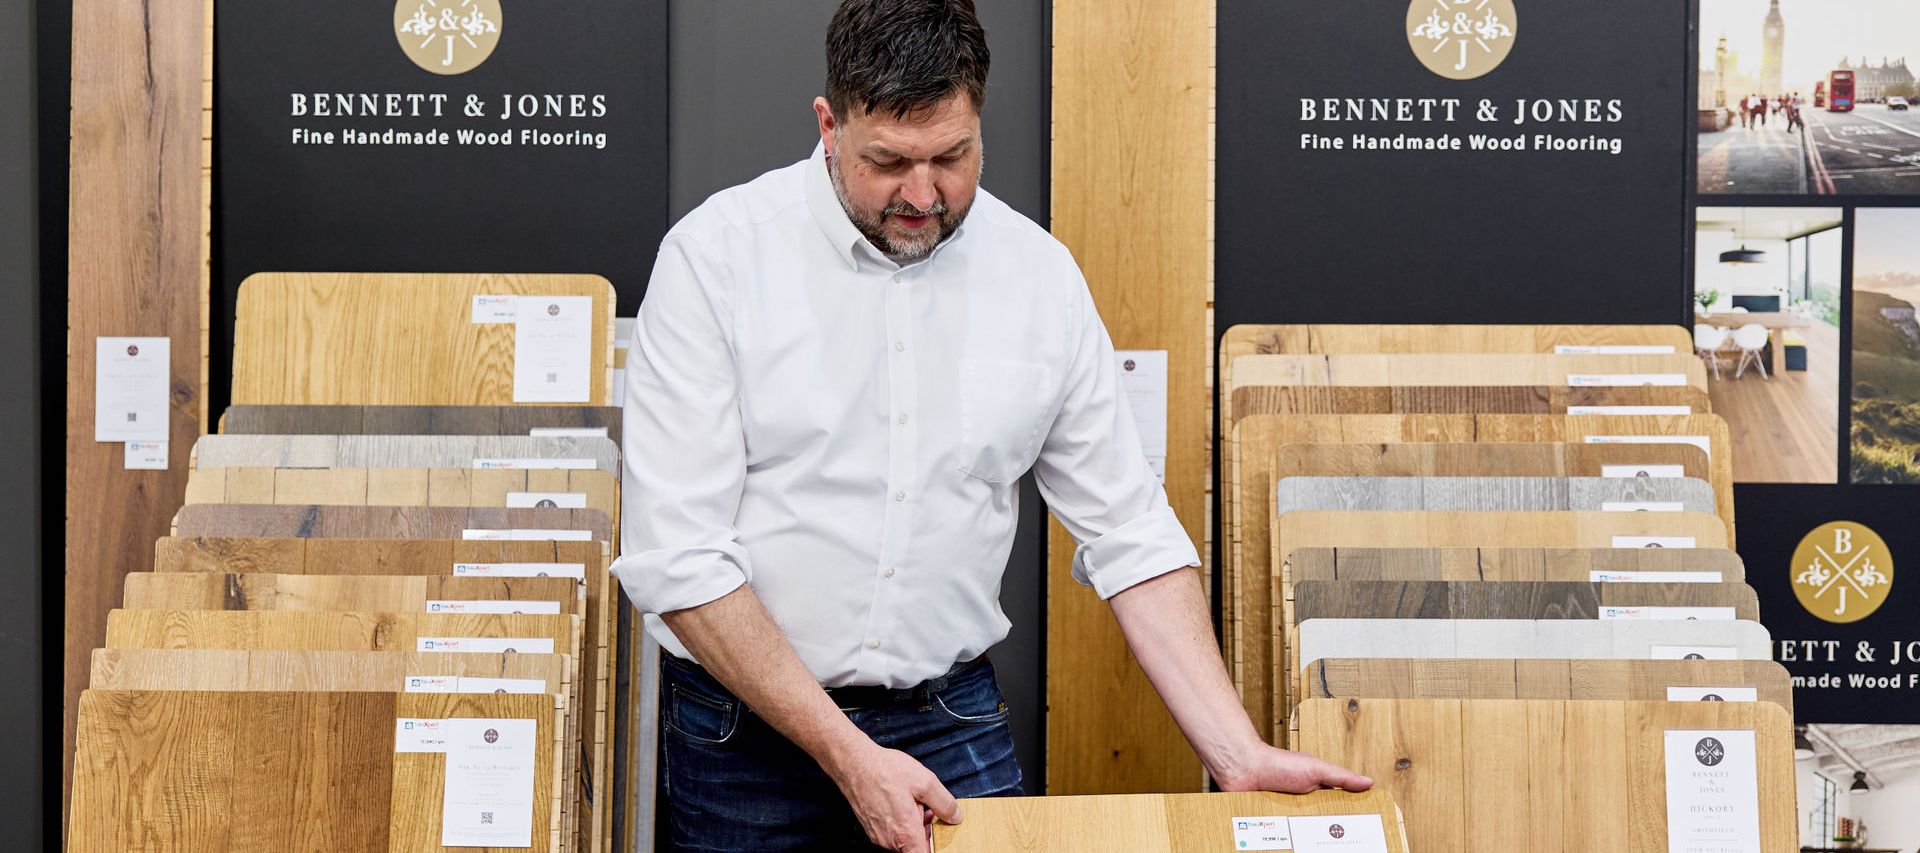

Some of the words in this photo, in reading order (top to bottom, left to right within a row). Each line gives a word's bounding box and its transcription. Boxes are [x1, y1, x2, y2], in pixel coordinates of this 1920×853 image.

[439, 7, 460, 30] &
[1452, 11, 1473, 35] &
[442, 35, 455, 66] J
[1454, 39, 1469, 70] J
[291, 94, 448, 117] BENNETT
[464, 94, 485, 117] &
[501, 94, 607, 119] JONES
[1299, 98, 1461, 122] BENNETT
[1476, 98, 1499, 122] &
[1514, 98, 1623, 124] JONES
[292, 128, 335, 145] Fine
[343, 128, 450, 145] Handmade
[457, 129, 513, 146] Wood
[521, 129, 607, 149] Flooring
[1301, 133, 1344, 150] Fine
[1353, 133, 1462, 150] Handmade
[1469, 134, 1526, 151] Wood
[1535, 134, 1622, 154] Flooring
[1834, 528, 1853, 554] B
[1834, 586, 1847, 615] J
[1855, 641, 1876, 662] &
[1848, 674, 1901, 689] Wood
[1706, 739, 1713, 747] B
[1707, 756, 1712, 764] J
[1690, 805, 1735, 813] HICKORY
